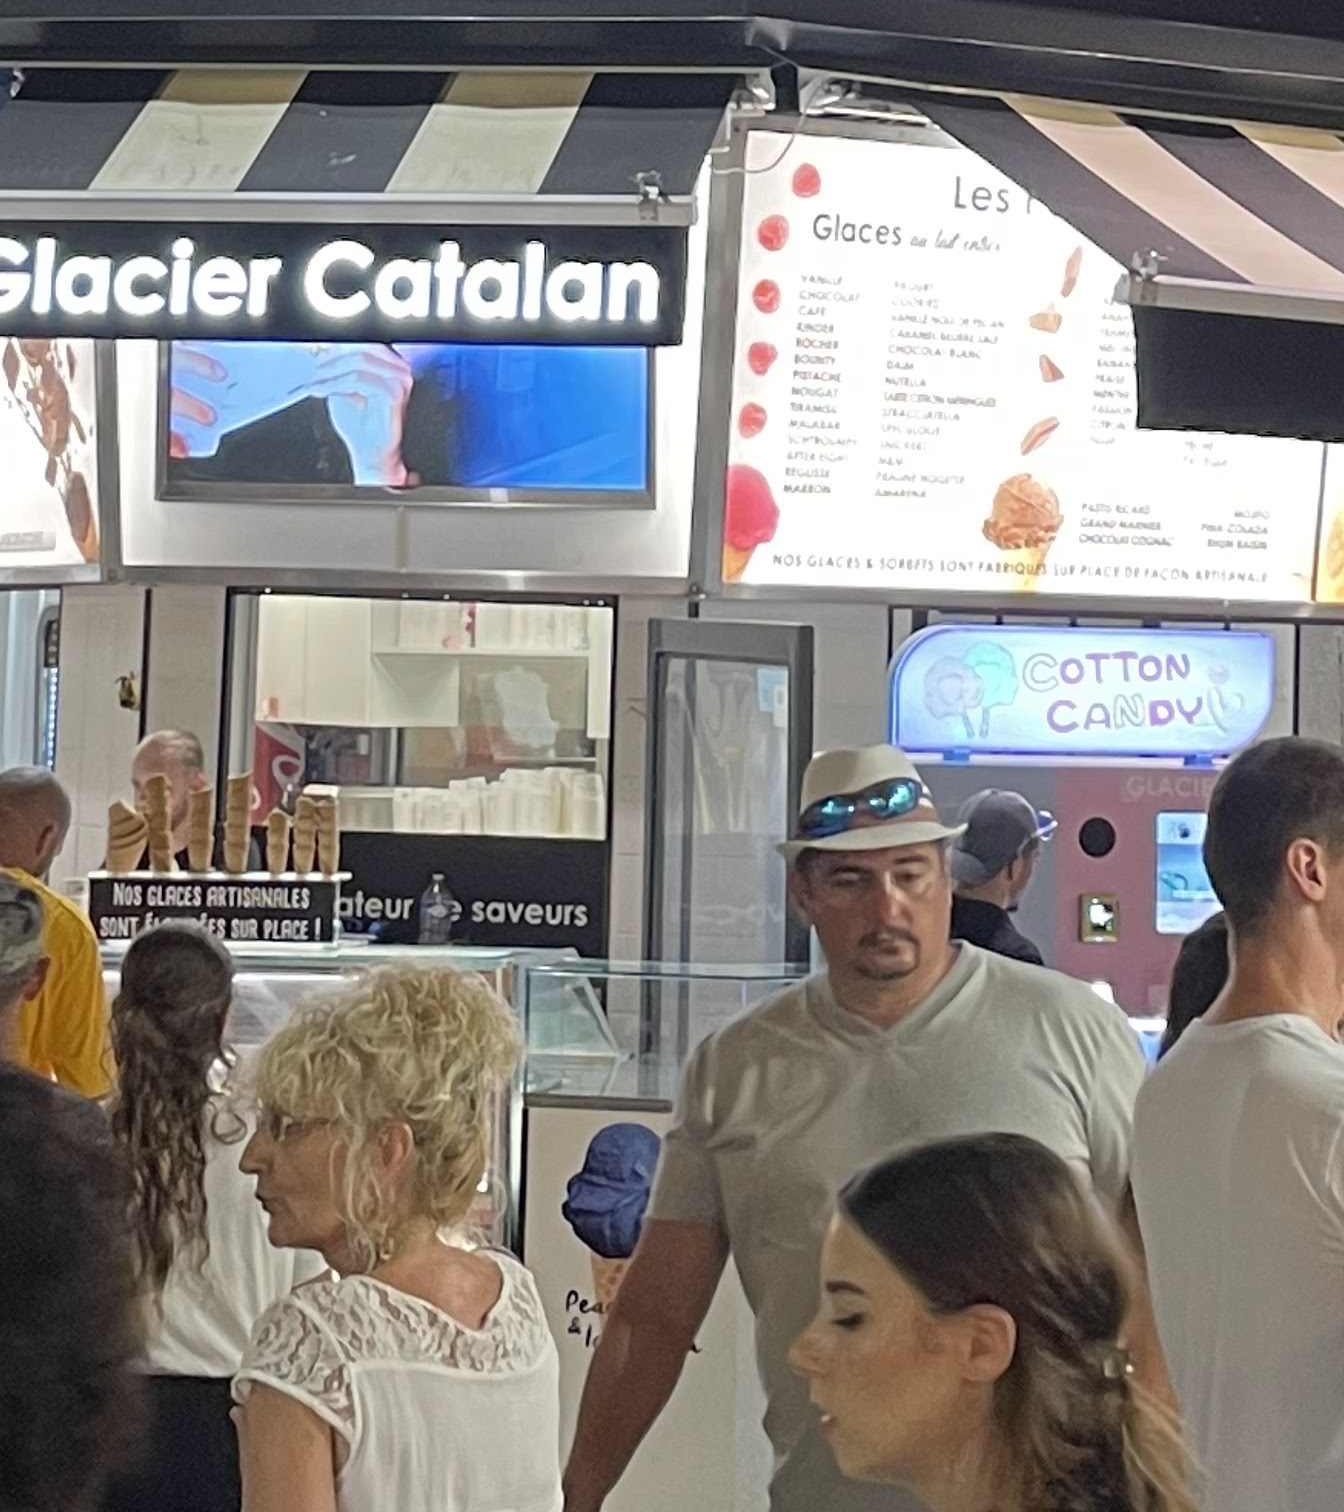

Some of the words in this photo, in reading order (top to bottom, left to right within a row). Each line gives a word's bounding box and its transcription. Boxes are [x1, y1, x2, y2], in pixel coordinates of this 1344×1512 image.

[954, 176, 1009, 213] Les
[813, 214, 902, 246] Glaces
[303, 240, 659, 323] Catalan
[773, 554, 802, 568] NOS
[807, 555, 860, 570] GLACES
[879, 557, 934, 572] SORBETS
[940, 559, 974, 573] SONT
[1054, 563, 1075, 577] SUR
[1080, 565, 1120, 578] PLACE
[1023, 650, 1191, 692] COTTON
[1046, 693, 1203, 734] CANDY
[1127, 776, 1214, 799] GLACIE
[113, 882, 143, 907] NOS
[147, 885, 202, 908] GLACES
[207, 885, 310, 909] ARTISANALES
[338, 890, 415, 920] ateur
[471, 900, 589, 927] saveurs
[99, 916, 139, 938] SONT
[231, 918, 258, 939] SUR
[264, 918, 309, 940] PLACE
[565, 1289, 612, 1314] Pea
